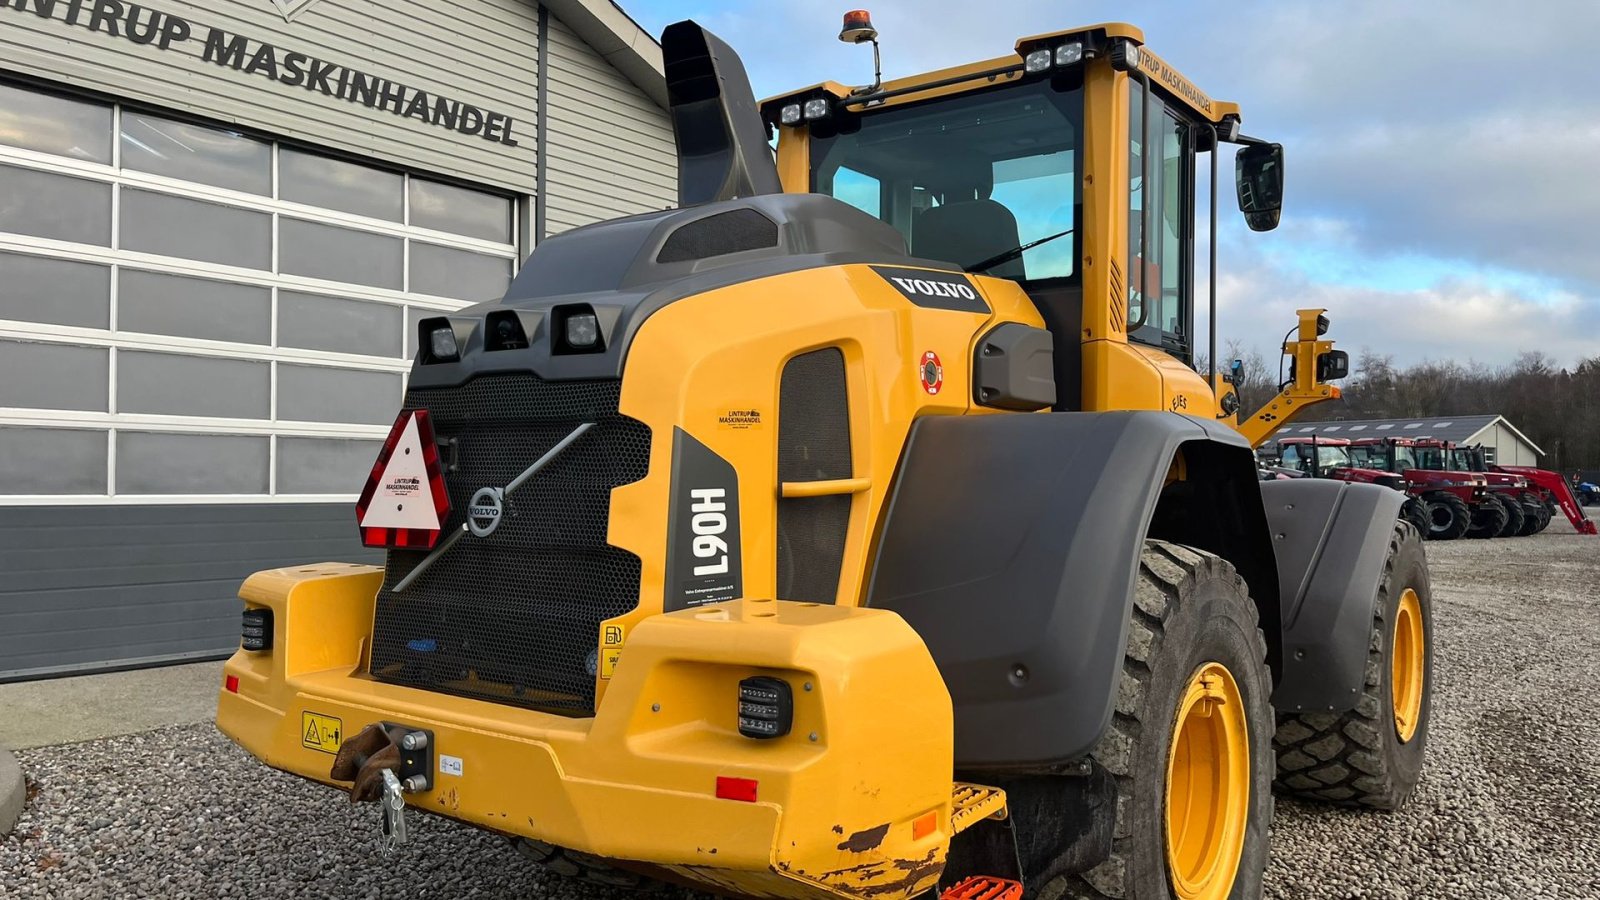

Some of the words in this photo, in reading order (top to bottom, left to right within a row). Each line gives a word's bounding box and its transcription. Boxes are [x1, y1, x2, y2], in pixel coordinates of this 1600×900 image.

[201, 28, 519, 146] MASKINHANDEL
[1160, 66, 1212, 114] MASKINHANDEL
[891, 277, 976, 301] VOLVO
[469, 508, 499, 516] VOLVO
[690, 488, 728, 576] L90H
